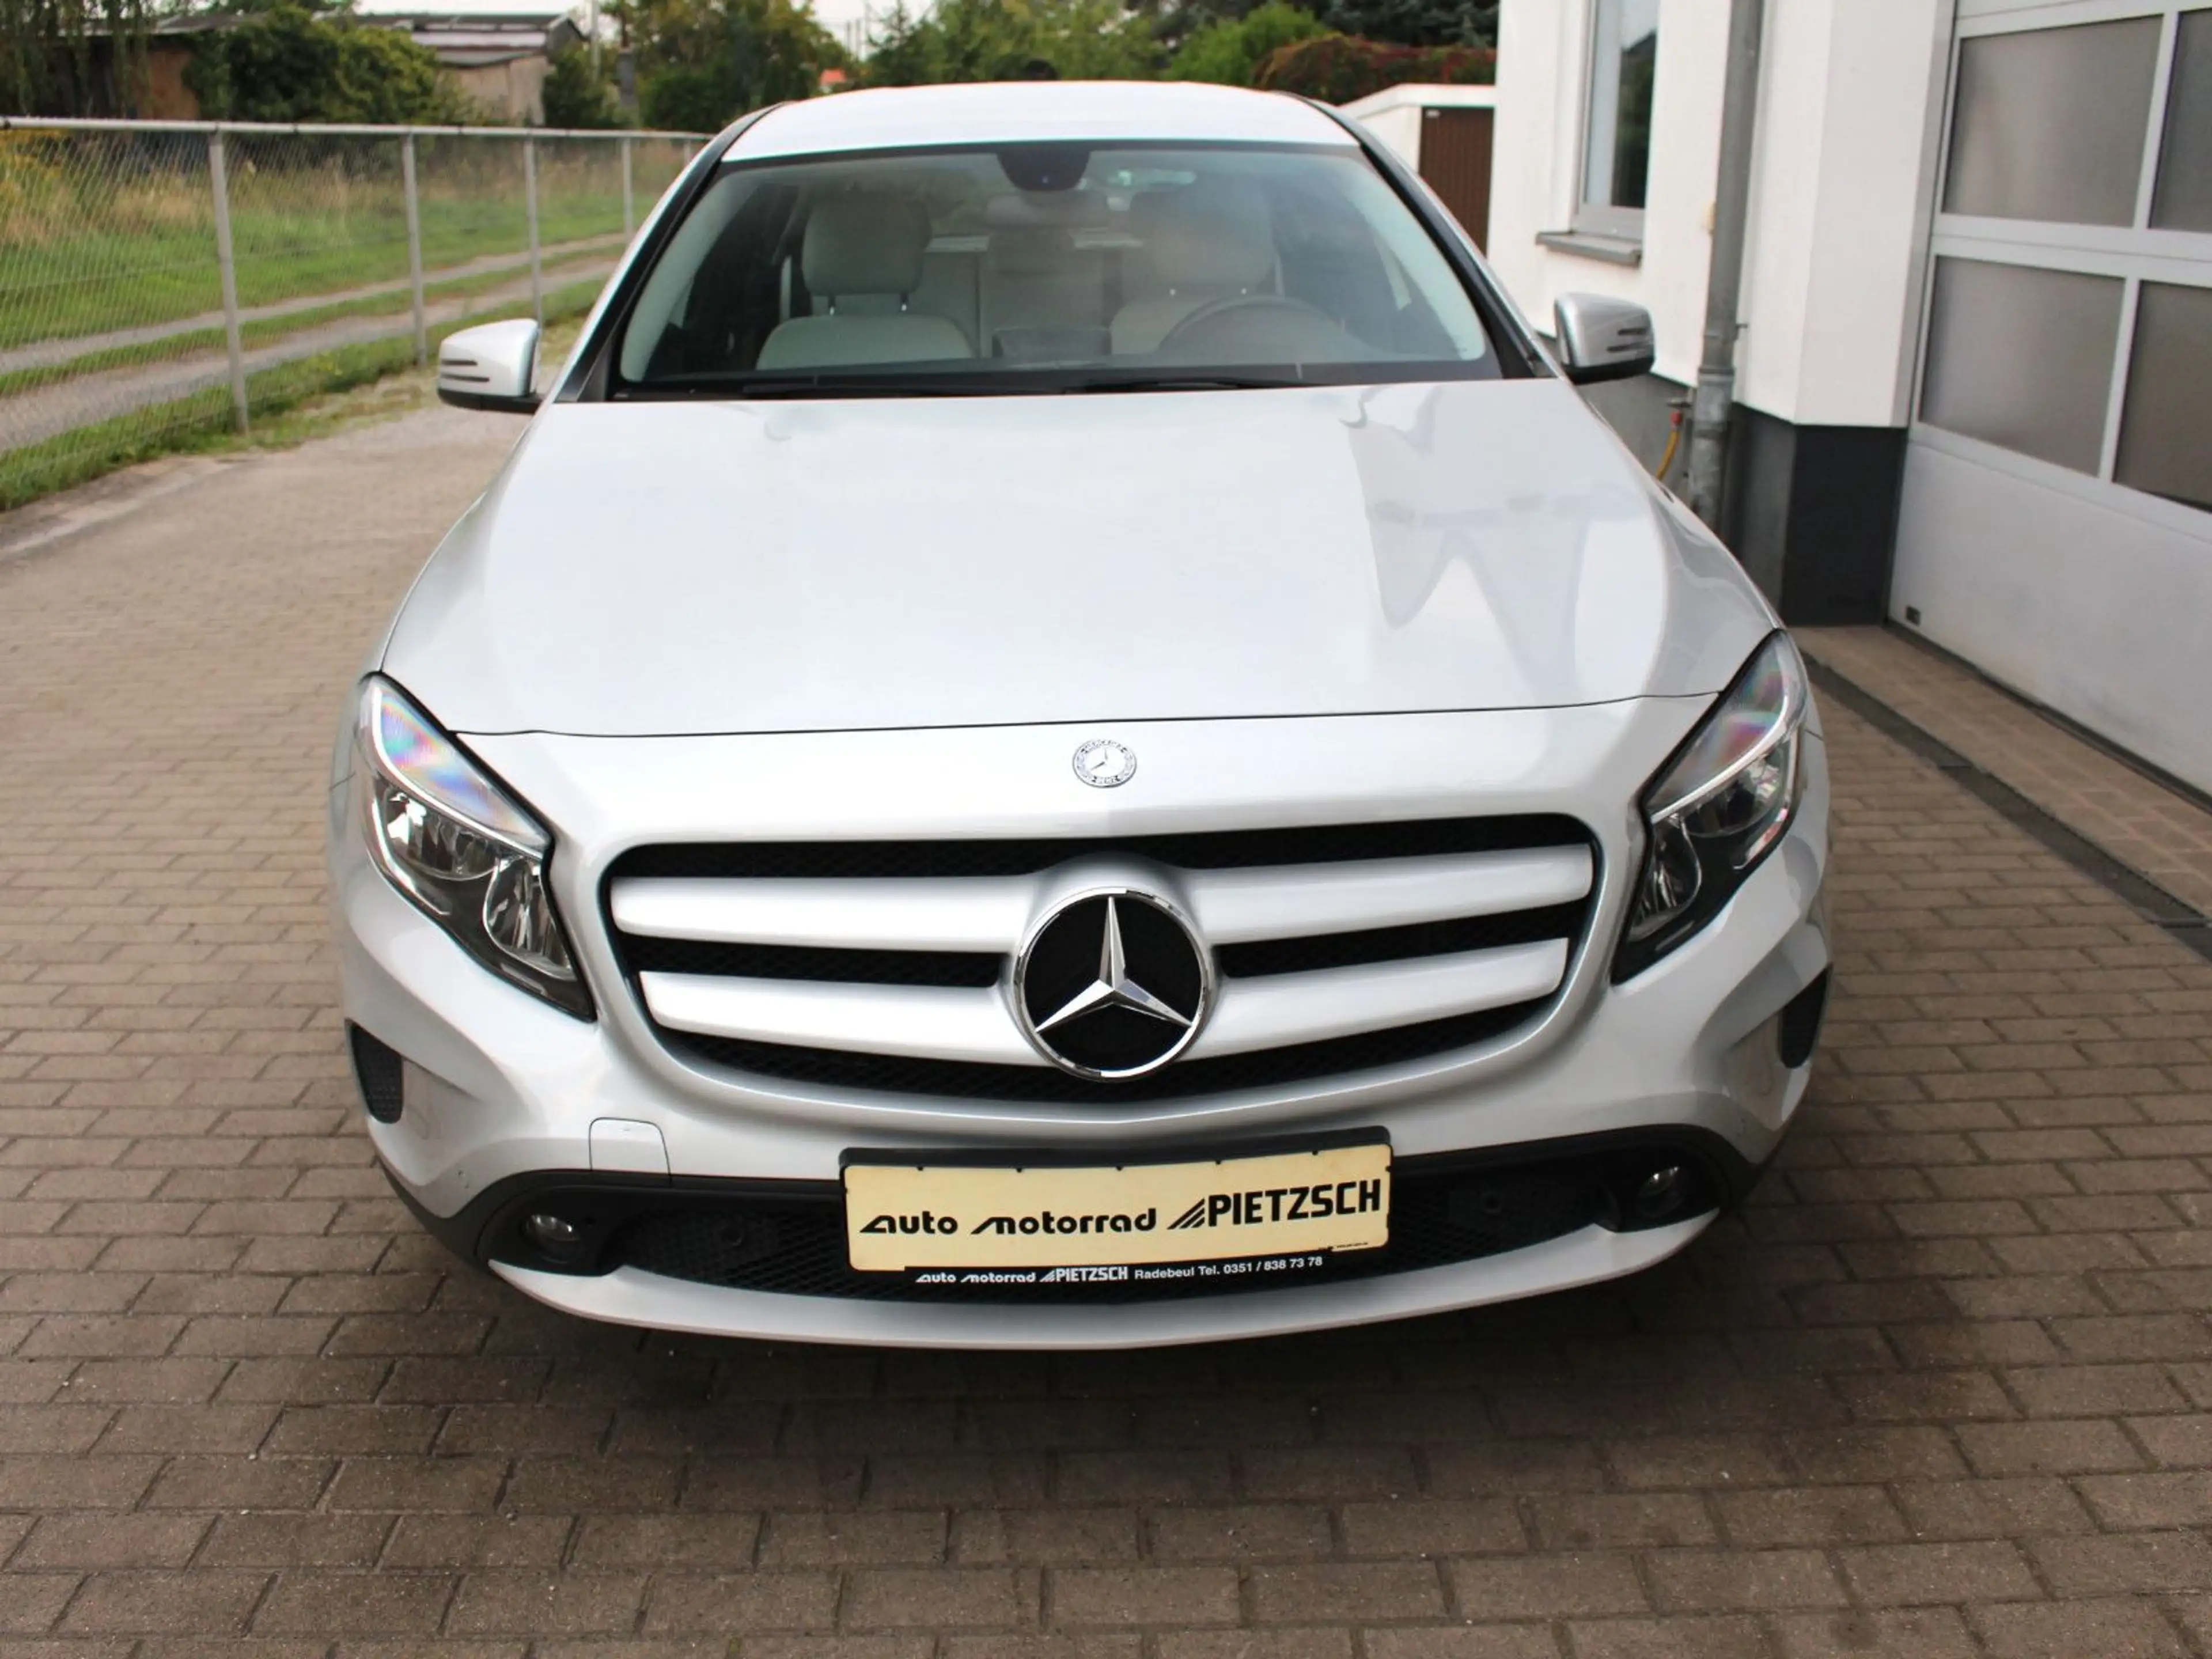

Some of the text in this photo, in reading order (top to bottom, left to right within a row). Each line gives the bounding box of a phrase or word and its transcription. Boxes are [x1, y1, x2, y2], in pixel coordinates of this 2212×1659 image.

[1208, 1178, 1381, 1227] PIETZSCH
[1055, 1266, 1128, 1282] PIETZSCH
[1134, 1267, 1195, 1280] Radebeul
[1198, 1266, 1221, 1276] Tel.
[1223, 1262, 1253, 1274] 0351
[1256, 1262, 1262, 1272] /
[1264, 1259, 1286, 1271] 838
[1290, 1257, 1305, 1268] 73
[1308, 1256, 1323, 1267] 78
